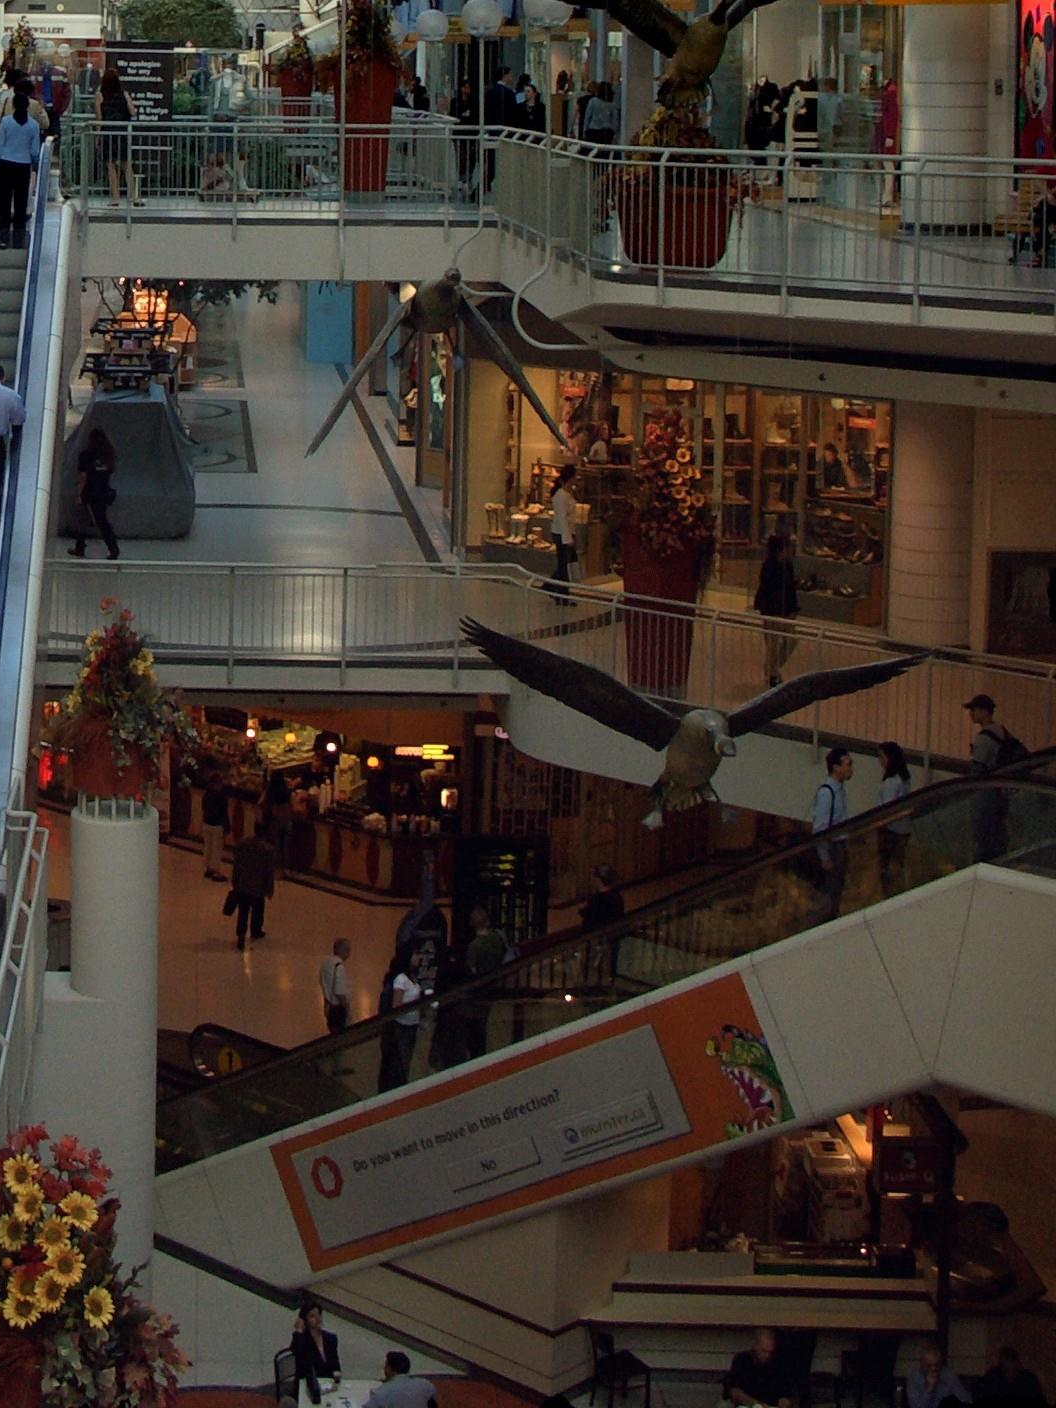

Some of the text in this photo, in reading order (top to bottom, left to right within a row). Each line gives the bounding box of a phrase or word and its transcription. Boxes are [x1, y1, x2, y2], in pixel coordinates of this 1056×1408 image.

[352, 1089, 561, 1173] Do you want to move in this direction?
[480, 1158, 497, 1173] No
